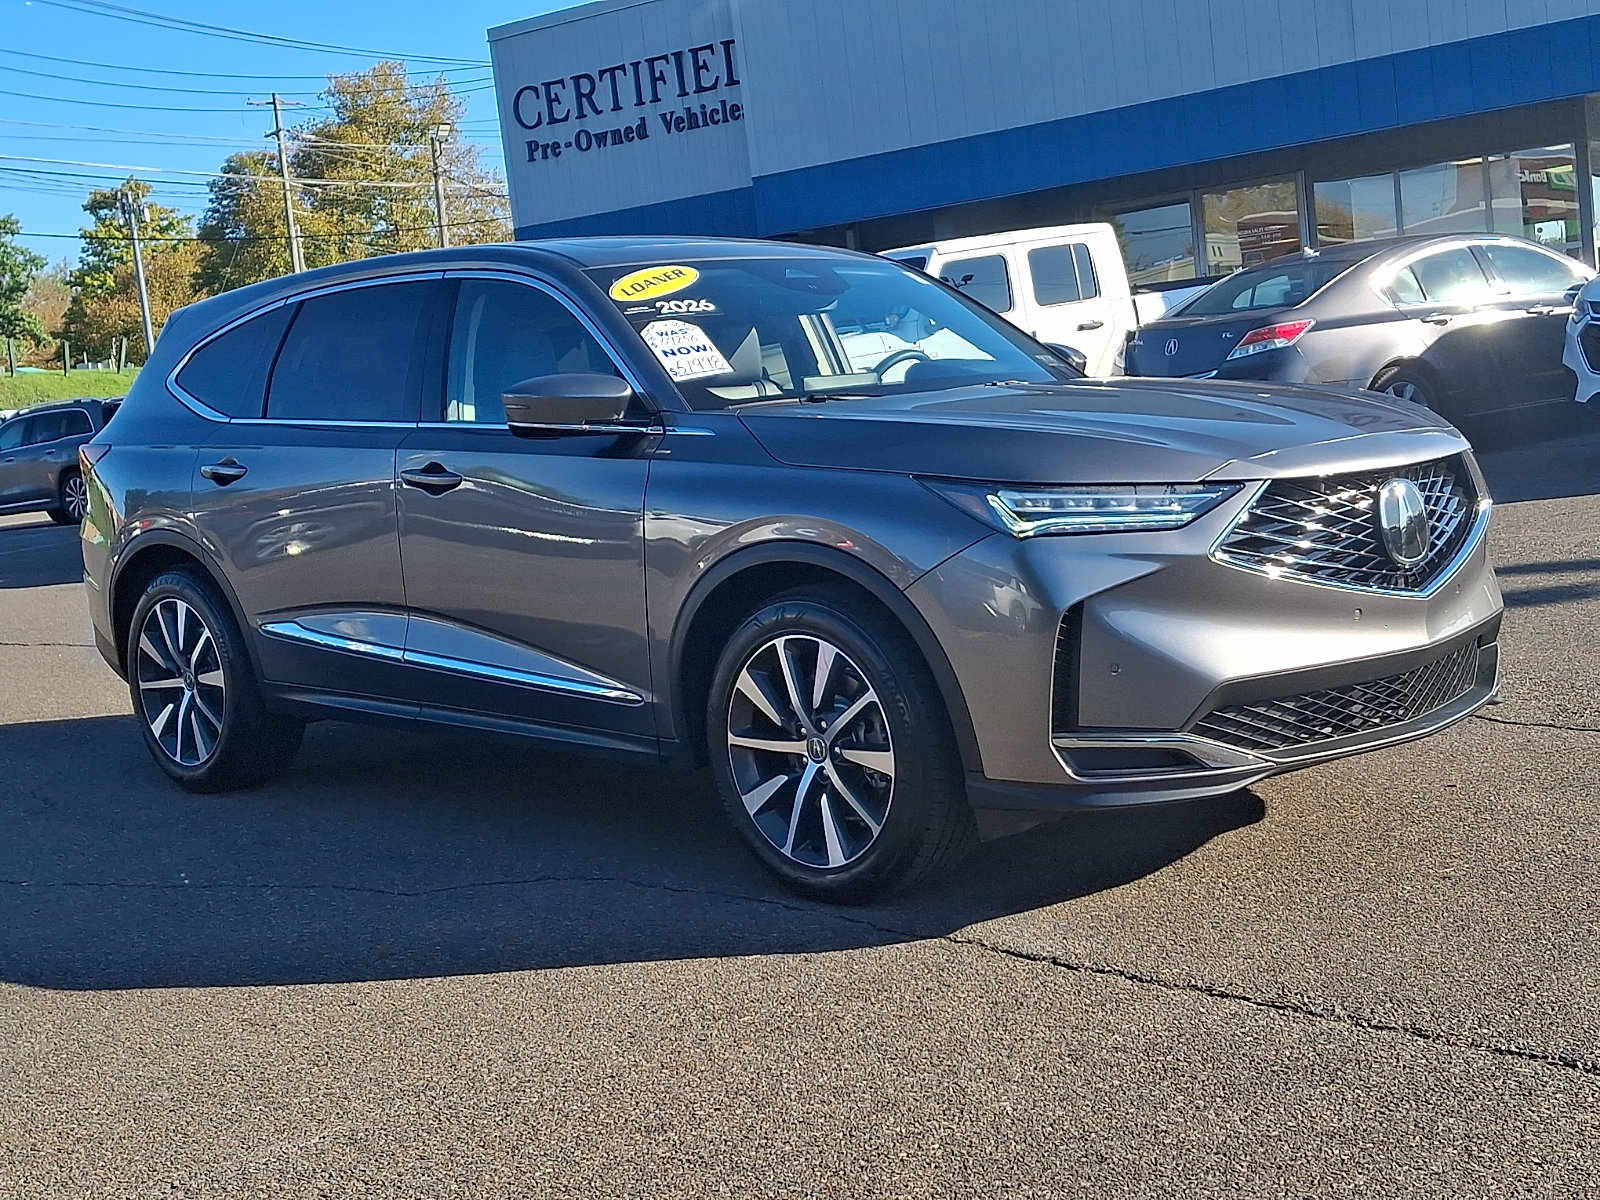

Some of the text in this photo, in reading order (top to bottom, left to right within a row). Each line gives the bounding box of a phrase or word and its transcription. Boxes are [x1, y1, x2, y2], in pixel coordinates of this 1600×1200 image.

[525, 116, 649, 162] Pre-Owned
[620, 268, 687, 297] LOANER
[655, 299, 716, 314] 2026
[656, 328, 688, 337] WAS
